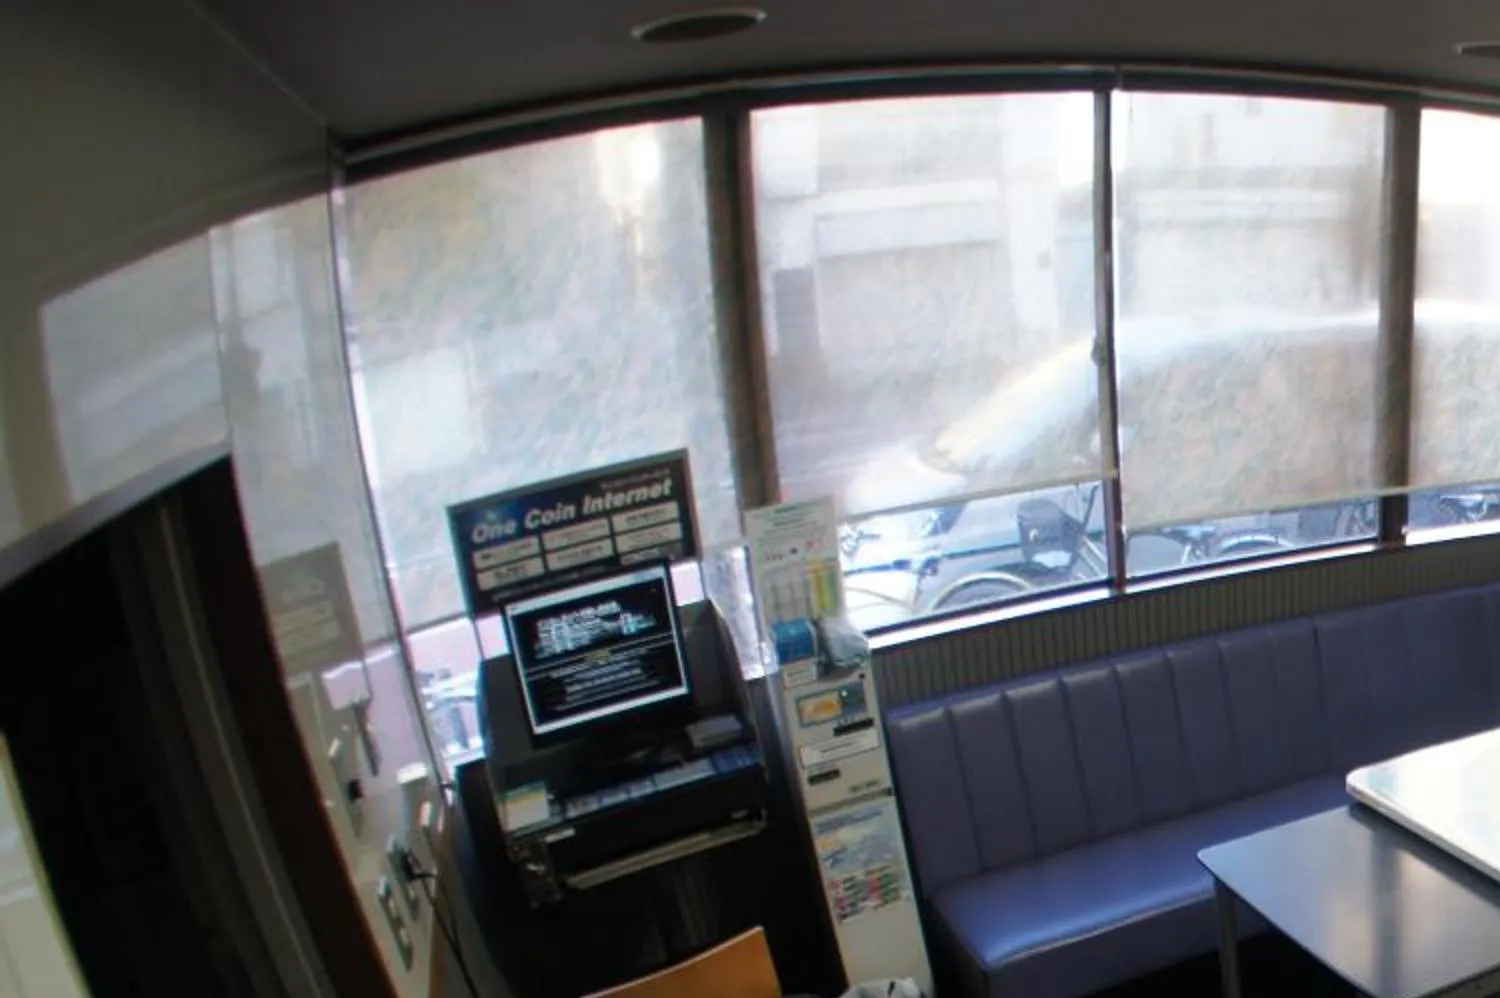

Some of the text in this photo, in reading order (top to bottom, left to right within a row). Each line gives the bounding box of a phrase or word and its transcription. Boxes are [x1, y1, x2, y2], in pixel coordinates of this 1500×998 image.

[471, 521, 517, 544] One
[524, 502, 576, 530] Coin
[583, 478, 673, 514] Internet
